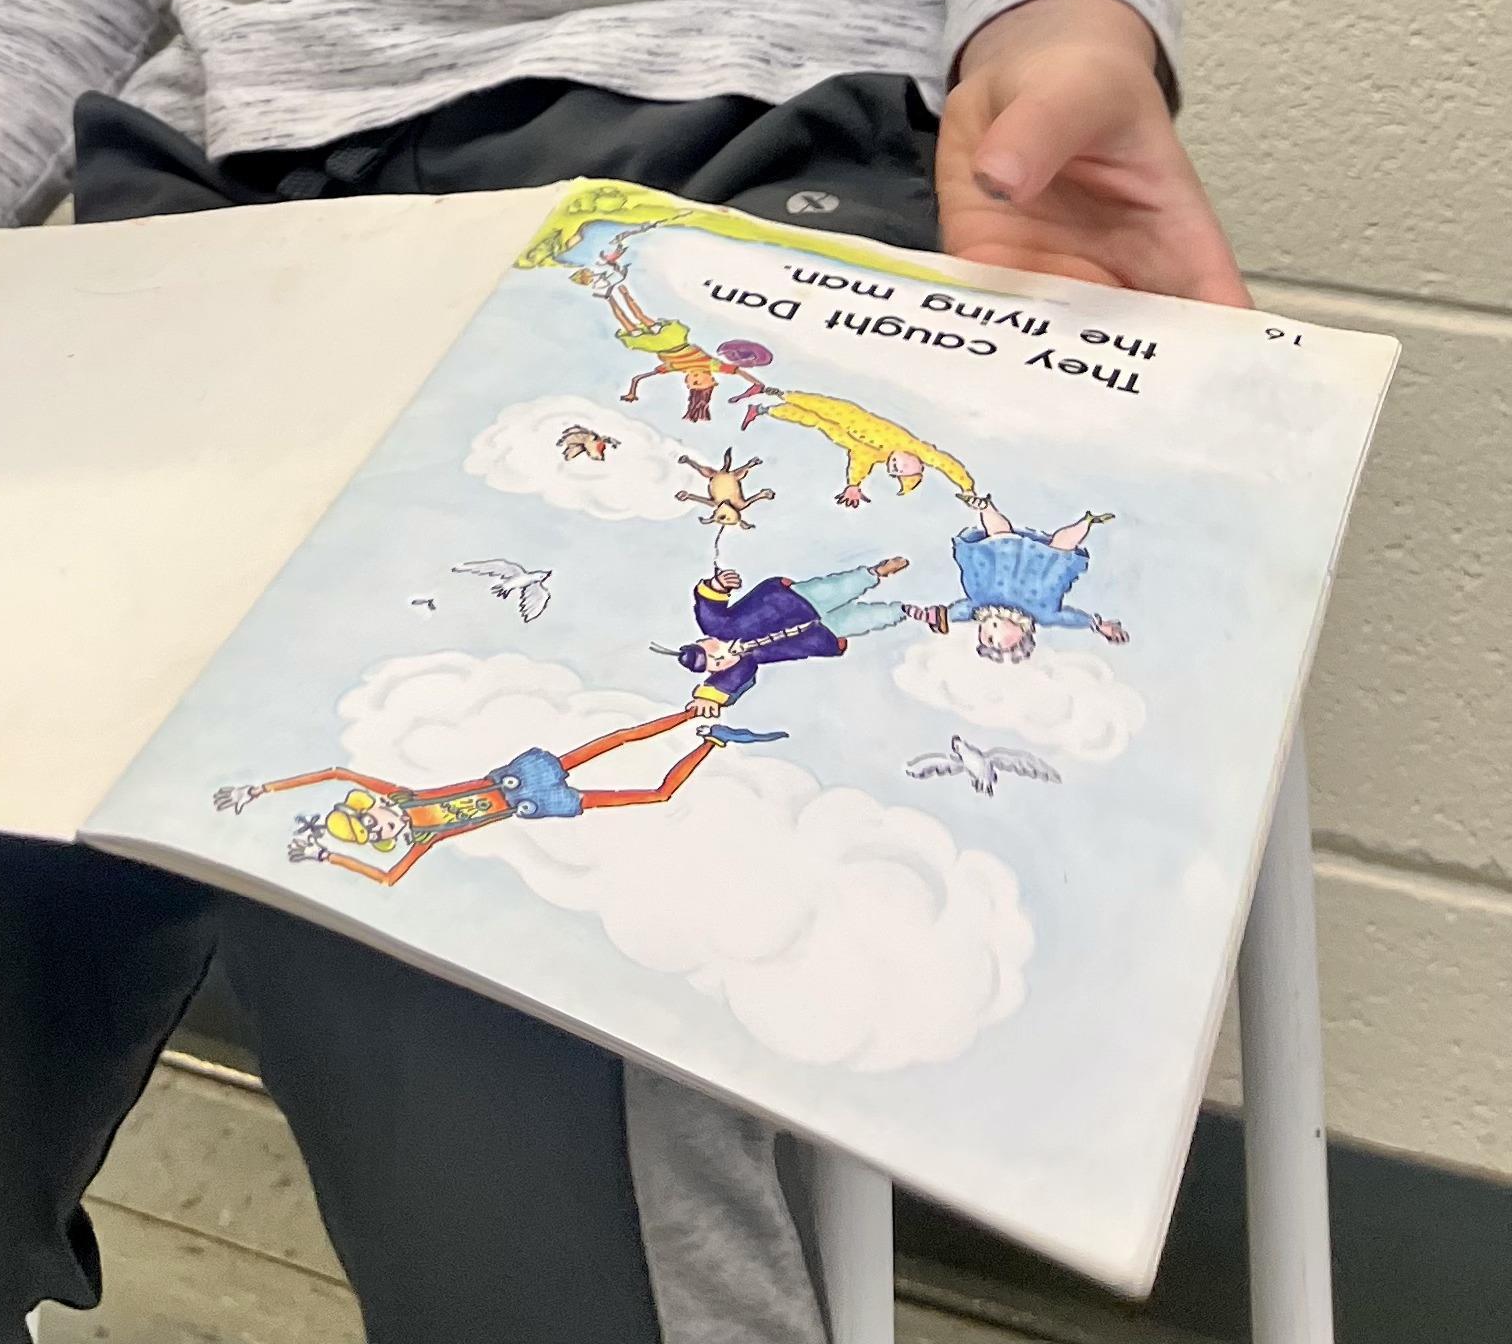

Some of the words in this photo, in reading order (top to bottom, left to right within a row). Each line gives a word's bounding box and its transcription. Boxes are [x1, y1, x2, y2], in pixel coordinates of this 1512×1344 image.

[703, 279, 802, 321] Dan,
[784, 265, 895, 300] man.
[825, 310, 997, 356] caught
[920, 293, 1051, 336] flying
[1080, 328, 1157, 360] the
[1265, 327, 1303, 348] 16
[1025, 348, 1140, 394] They
